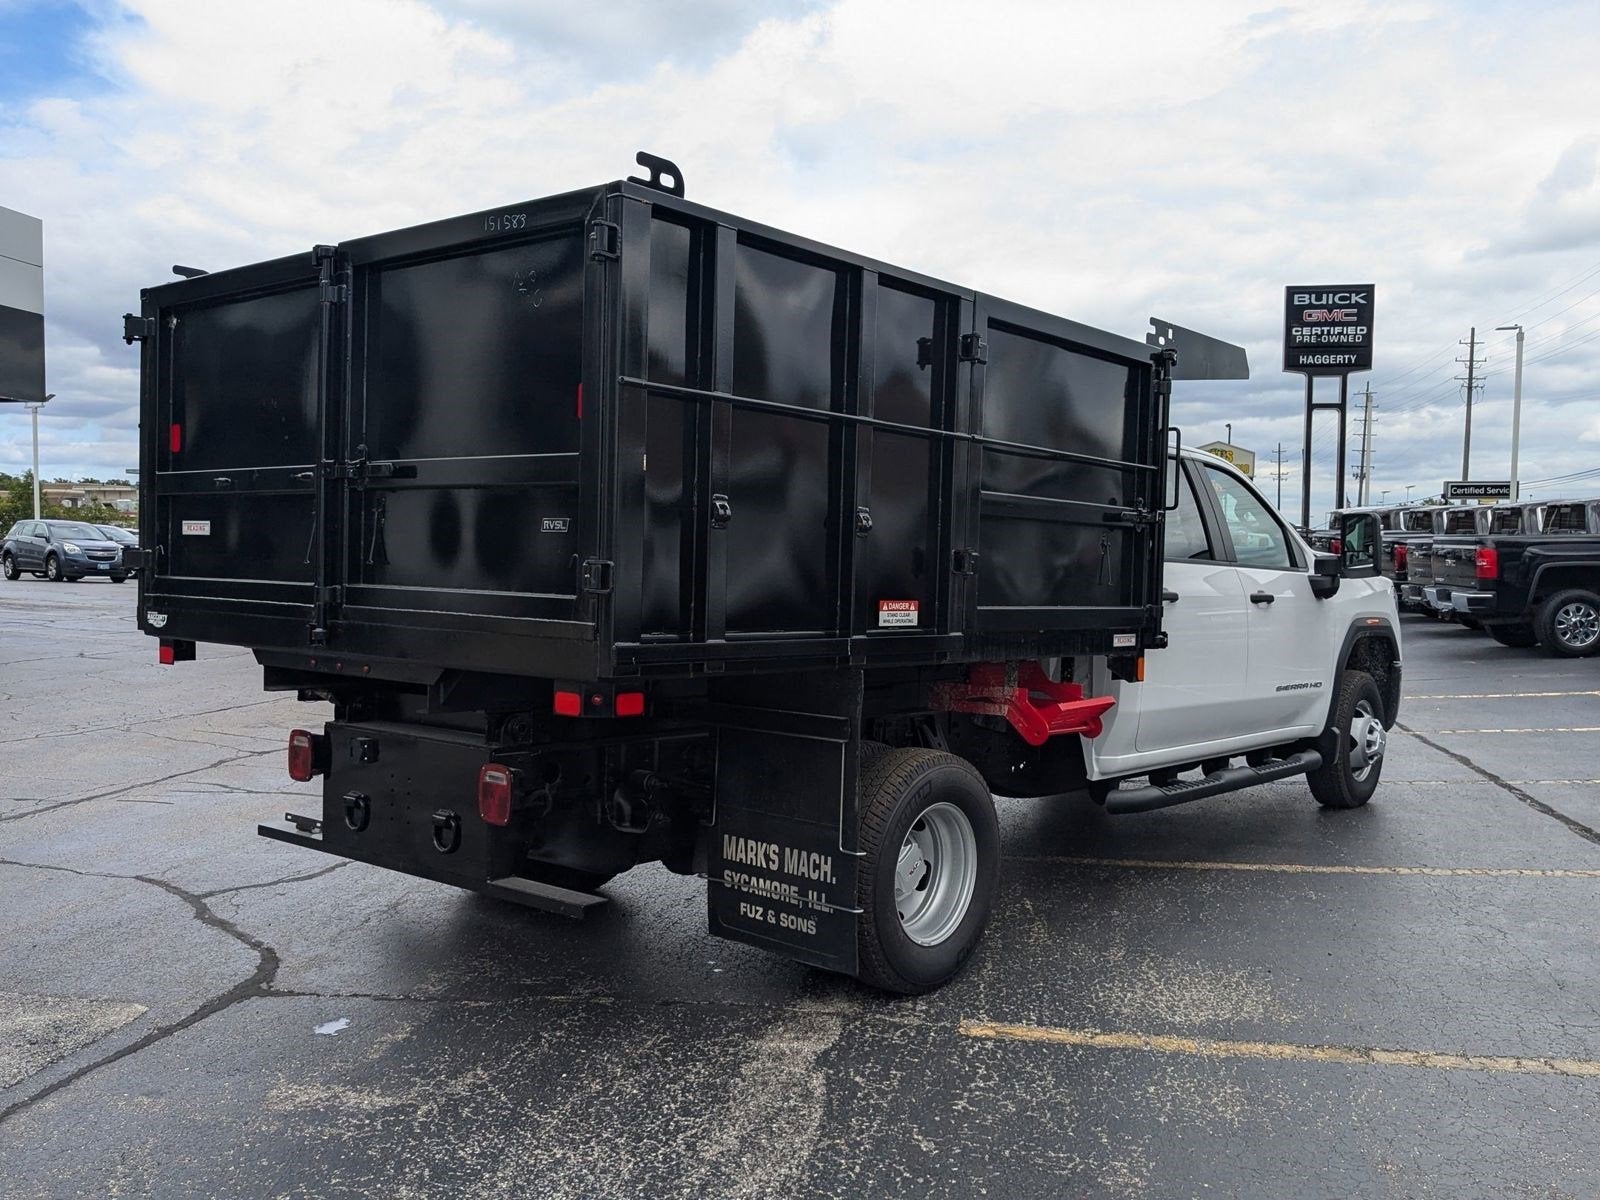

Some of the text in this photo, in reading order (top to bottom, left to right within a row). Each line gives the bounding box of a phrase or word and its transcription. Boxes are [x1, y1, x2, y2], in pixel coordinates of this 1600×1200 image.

[1293, 293, 1367, 305] BUICK
[1303, 309, 1357, 321] GMC
[1292, 326, 1367, 335] CERTIFIED
[1296, 335, 1362, 343] PRE-OWNED
[1299, 355, 1357, 365] HAGGERTY
[543, 520, 566, 530] RVSL
[888, 602, 910, 610] DANGER
[1276, 682, 1309, 692] SIERRA
[723, 834, 837, 885] MARK'S MACH.
[723, 869, 835, 914] SYCAMORE, ILL.
[739, 902, 817, 935] FUZ & SONS
